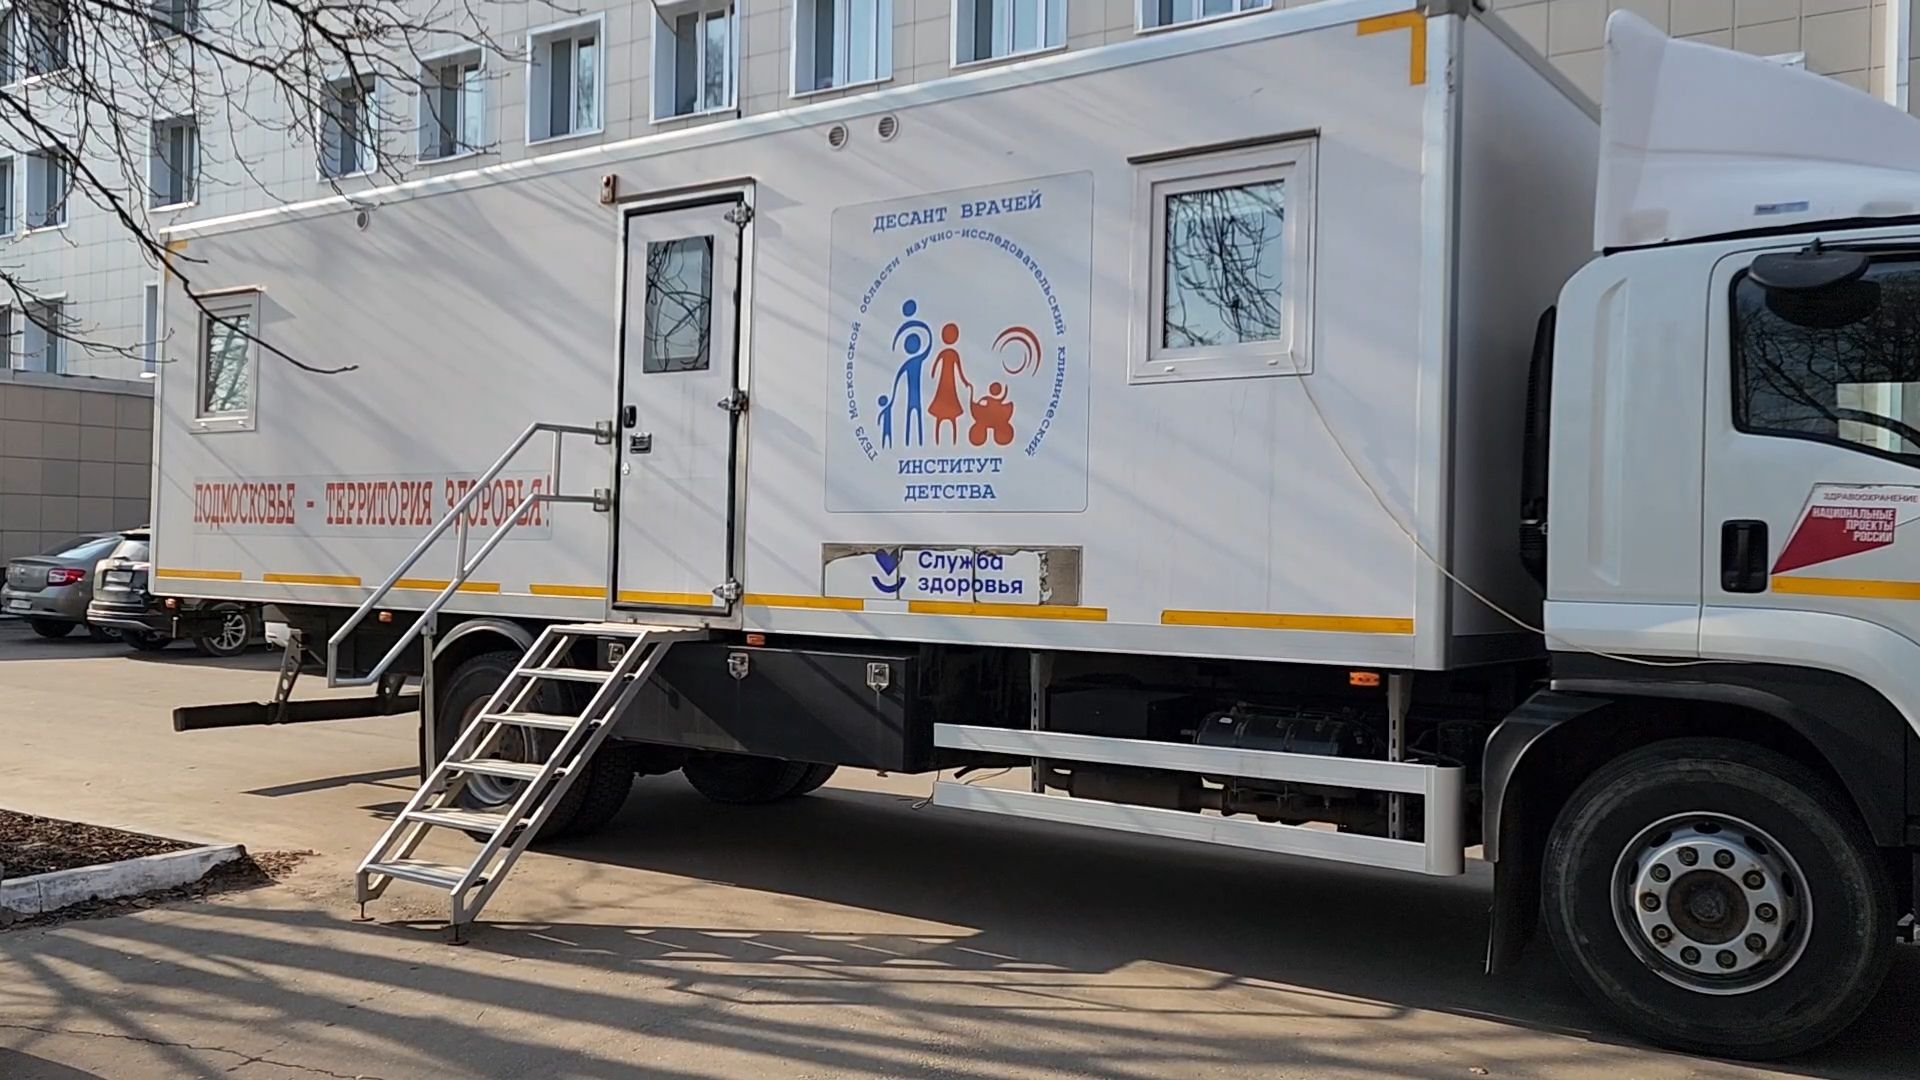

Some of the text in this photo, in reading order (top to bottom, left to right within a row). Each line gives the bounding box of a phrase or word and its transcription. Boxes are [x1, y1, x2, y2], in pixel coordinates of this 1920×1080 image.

[873, 189, 1043, 233] ДЕСАНТ ВРАЧЕЙ
[860, 256, 900, 314] области
[846, 321, 862, 420] Московской
[1024, 345, 1066, 457] клинический
[855, 425, 878, 461] ГБУЗ
[898, 457, 1002, 475] ИНСТИТУТ
[904, 484, 997, 502] ДЕТСТВА
[194, 482, 295, 531] ПОДМОСКОВЬЕ
[325, 481, 432, 526] ТЕРРИТОРИЯ
[1812, 507, 1894, 520] НАЦИОНАЛЬНЫЕ
[1845, 519, 1893, 531] ПРОЕКТЫ
[1853, 531, 1893, 542] РОССИИ
[918, 550, 1004, 573] Служба
[918, 576, 1024, 597] здоровья
